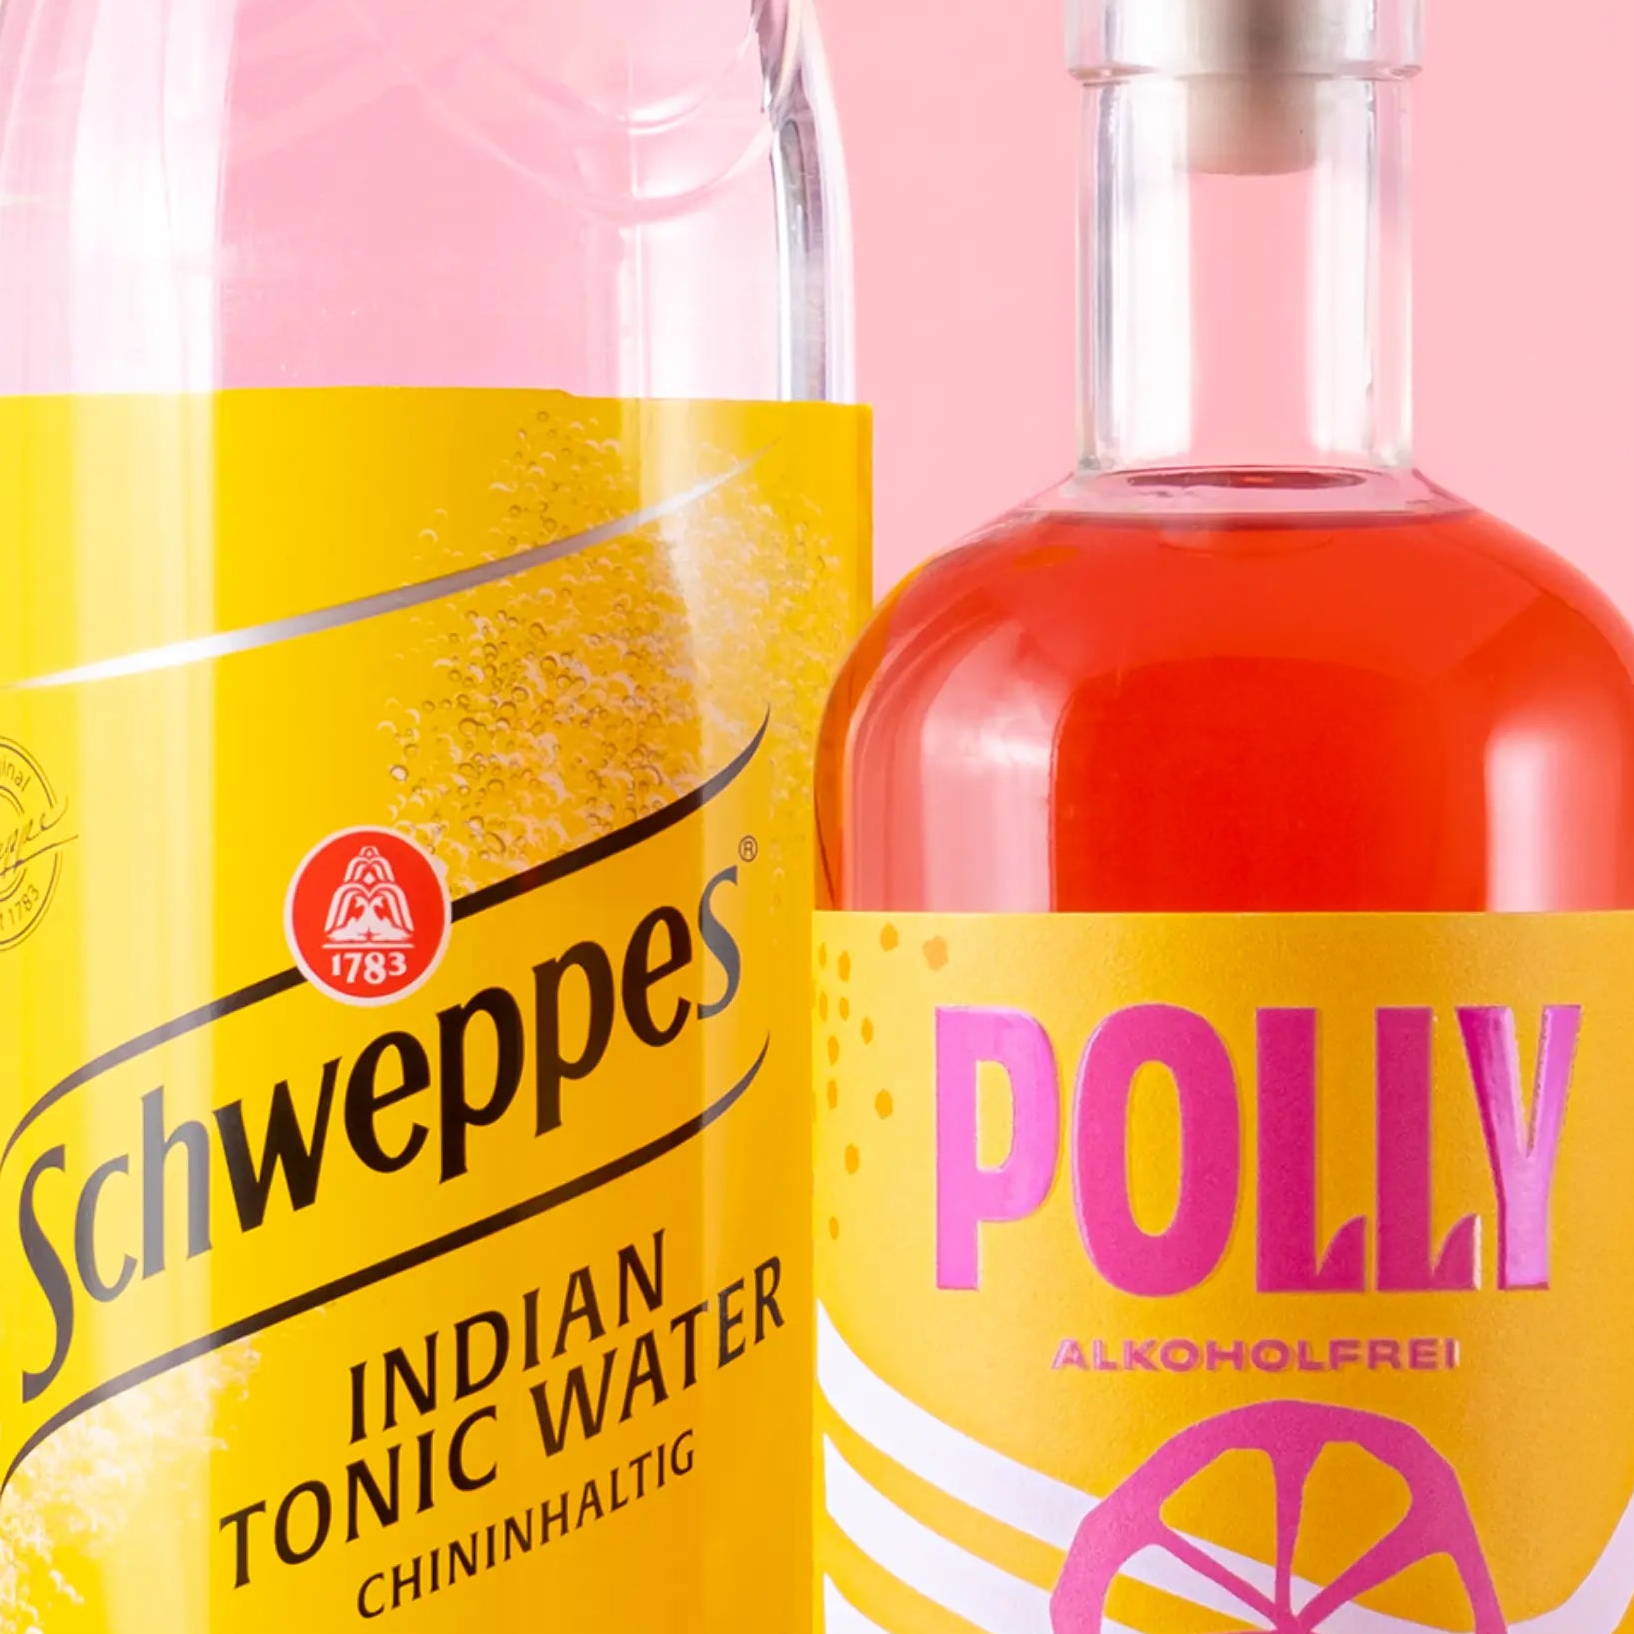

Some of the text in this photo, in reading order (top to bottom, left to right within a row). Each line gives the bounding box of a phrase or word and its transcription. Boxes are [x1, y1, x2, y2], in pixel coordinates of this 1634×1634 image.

[8, 884, 40, 927] 1783
[330, 950, 408, 986] 1783
[18, 864, 743, 1399] Schweppes
[935, 1003, 1582, 1298] POLLY
[219, 1255, 786, 1590] TONIC WATER
[348, 1228, 666, 1445] INDIAN
[1051, 1337, 1460, 1372] ALKOHOLFREI
[357, 1429, 695, 1619] CHININHALTIG
